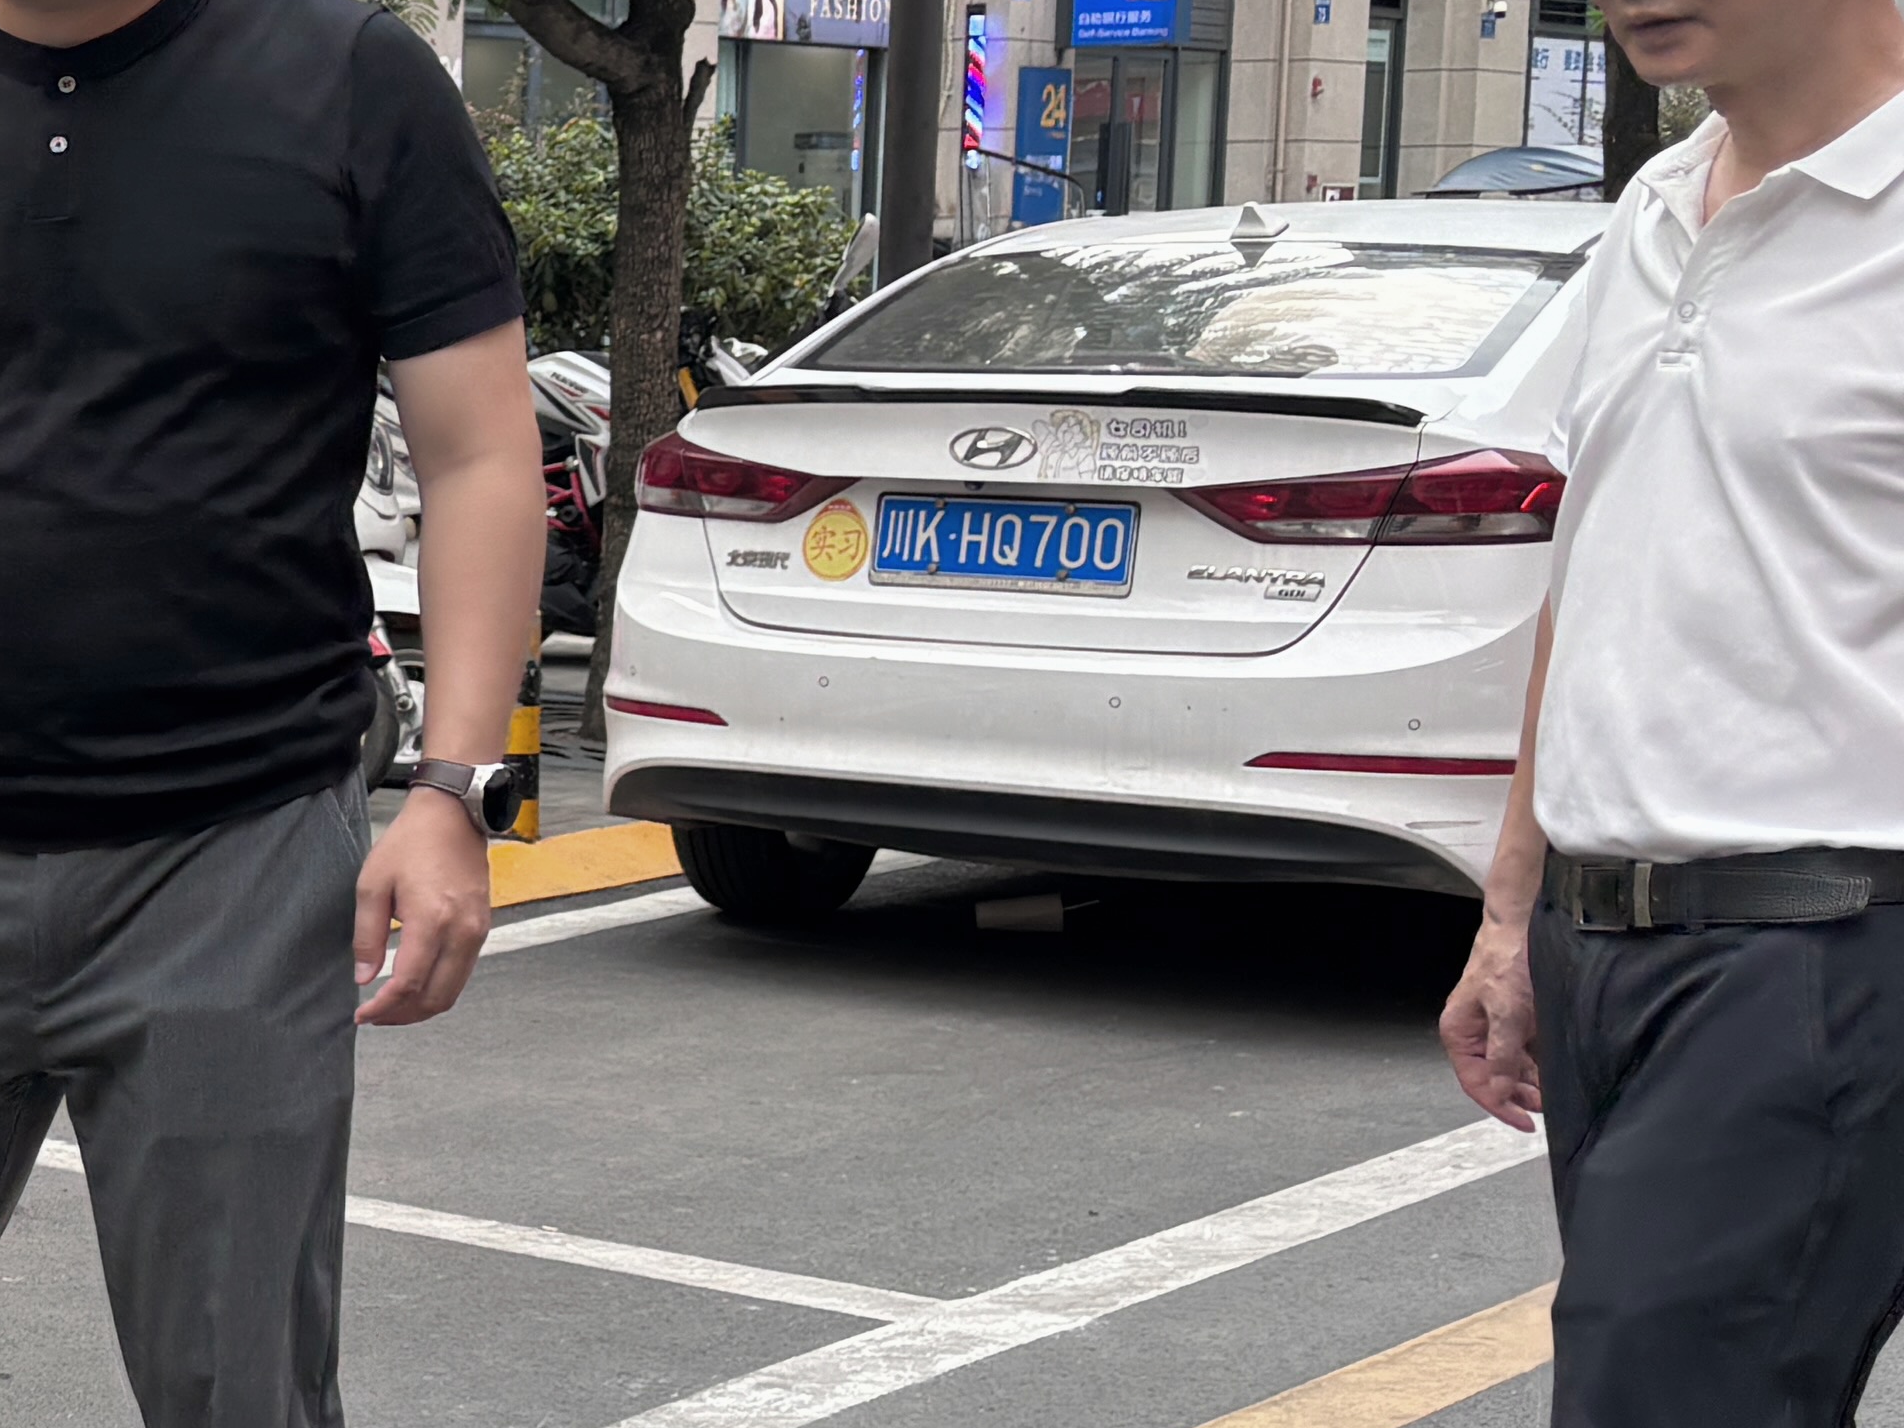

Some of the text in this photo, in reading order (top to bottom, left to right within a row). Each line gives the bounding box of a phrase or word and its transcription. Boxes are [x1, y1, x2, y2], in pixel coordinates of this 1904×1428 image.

[1040, 83, 1067, 129] 24
[809, 525, 863, 562] 实习
[881, 508, 1126, 572] 川K·HQ700
